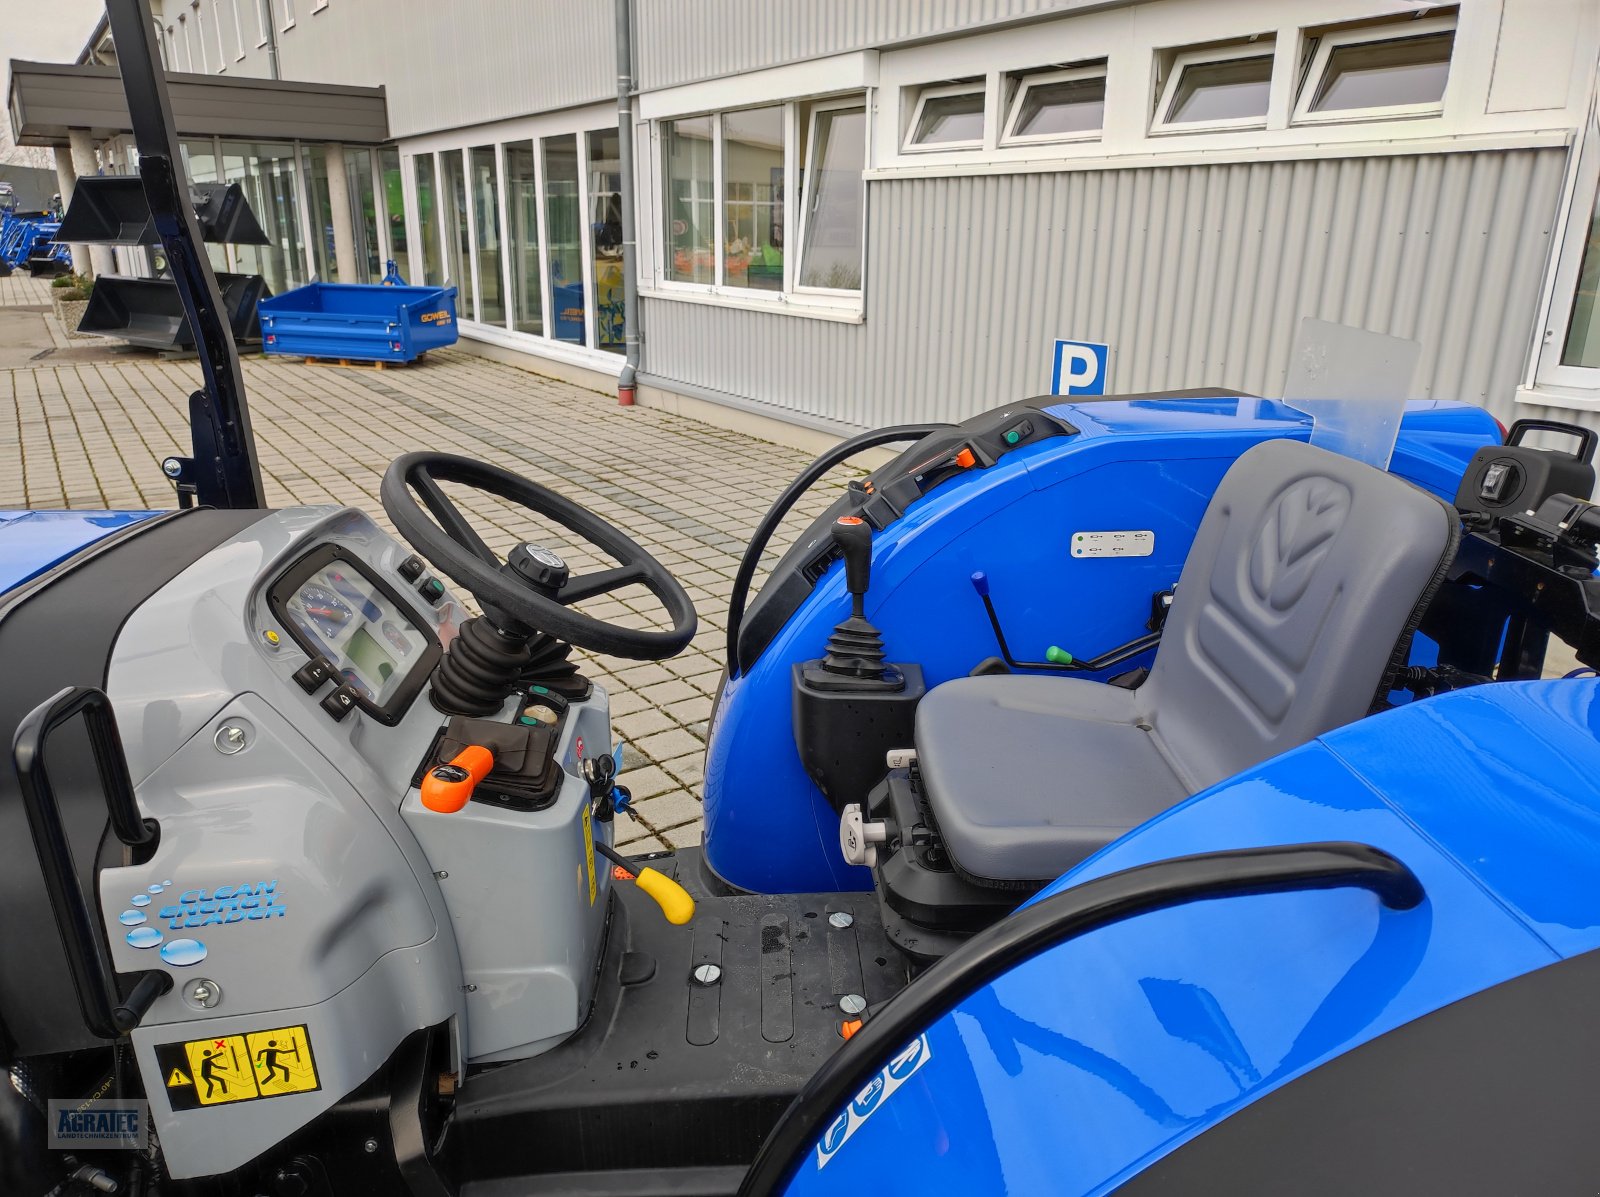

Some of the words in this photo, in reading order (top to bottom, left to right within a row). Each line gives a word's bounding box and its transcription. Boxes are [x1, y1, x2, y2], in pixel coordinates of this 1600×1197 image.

[1059, 344, 1098, 395] P
[180, 880, 277, 904] CLEAN
[158, 892, 284, 918] ENERGY
[169, 905, 286, 929] LEADER
